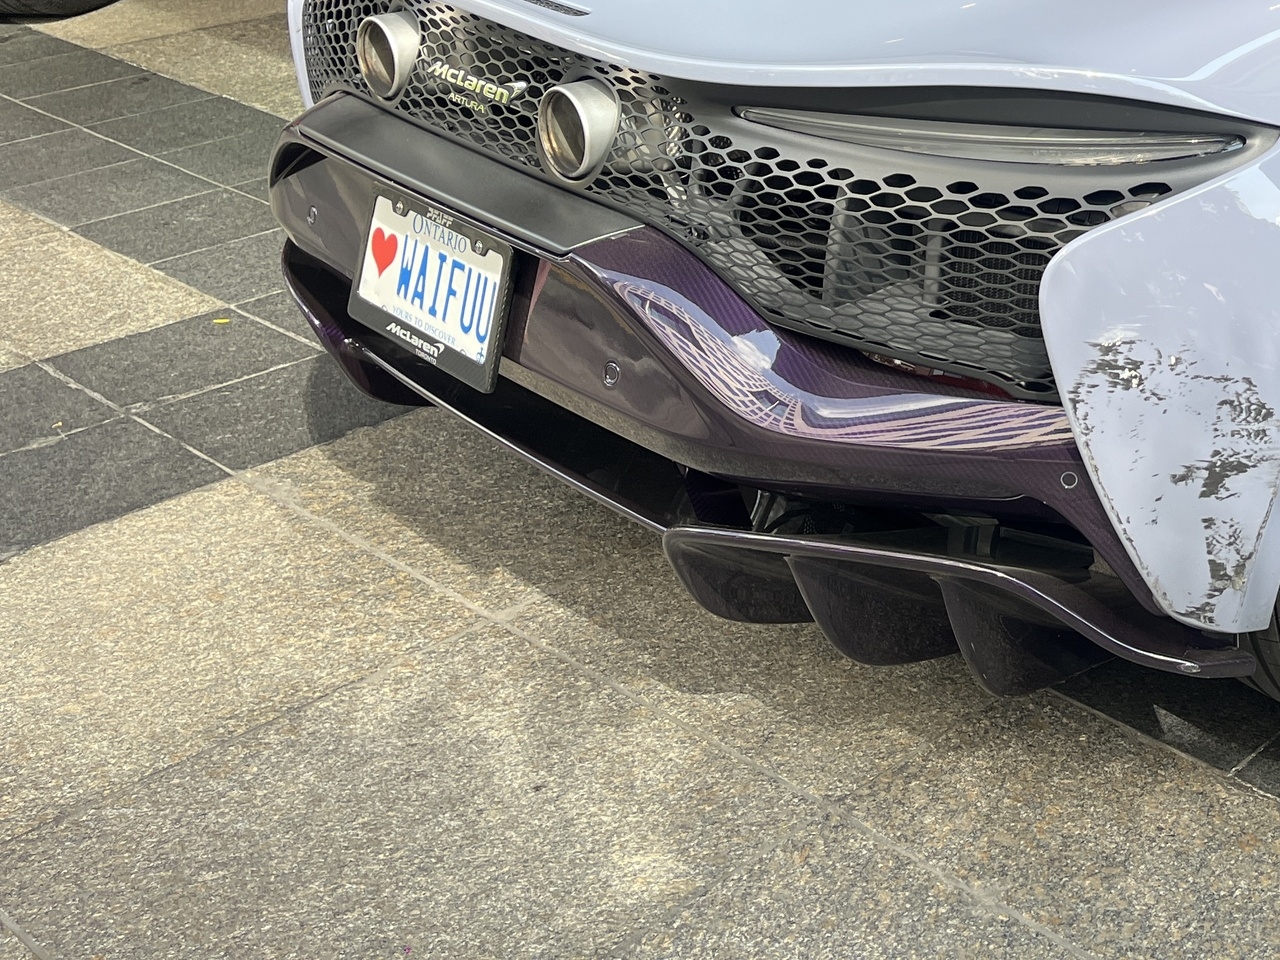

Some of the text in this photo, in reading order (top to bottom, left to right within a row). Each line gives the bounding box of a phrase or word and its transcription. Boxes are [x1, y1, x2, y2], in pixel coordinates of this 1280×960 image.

[427, 61, 510, 104] McLaren
[448, 92, 486, 114] ARTURA
[412, 213, 467, 254] ONTARIO
[426, 206, 454, 227] PFAFF
[396, 233, 497, 344] WAIFUU
[386, 322, 440, 357] McLaren
[391, 305, 456, 346] YOURS TO DISCOVER
[415, 349, 437, 365] TORONTO
